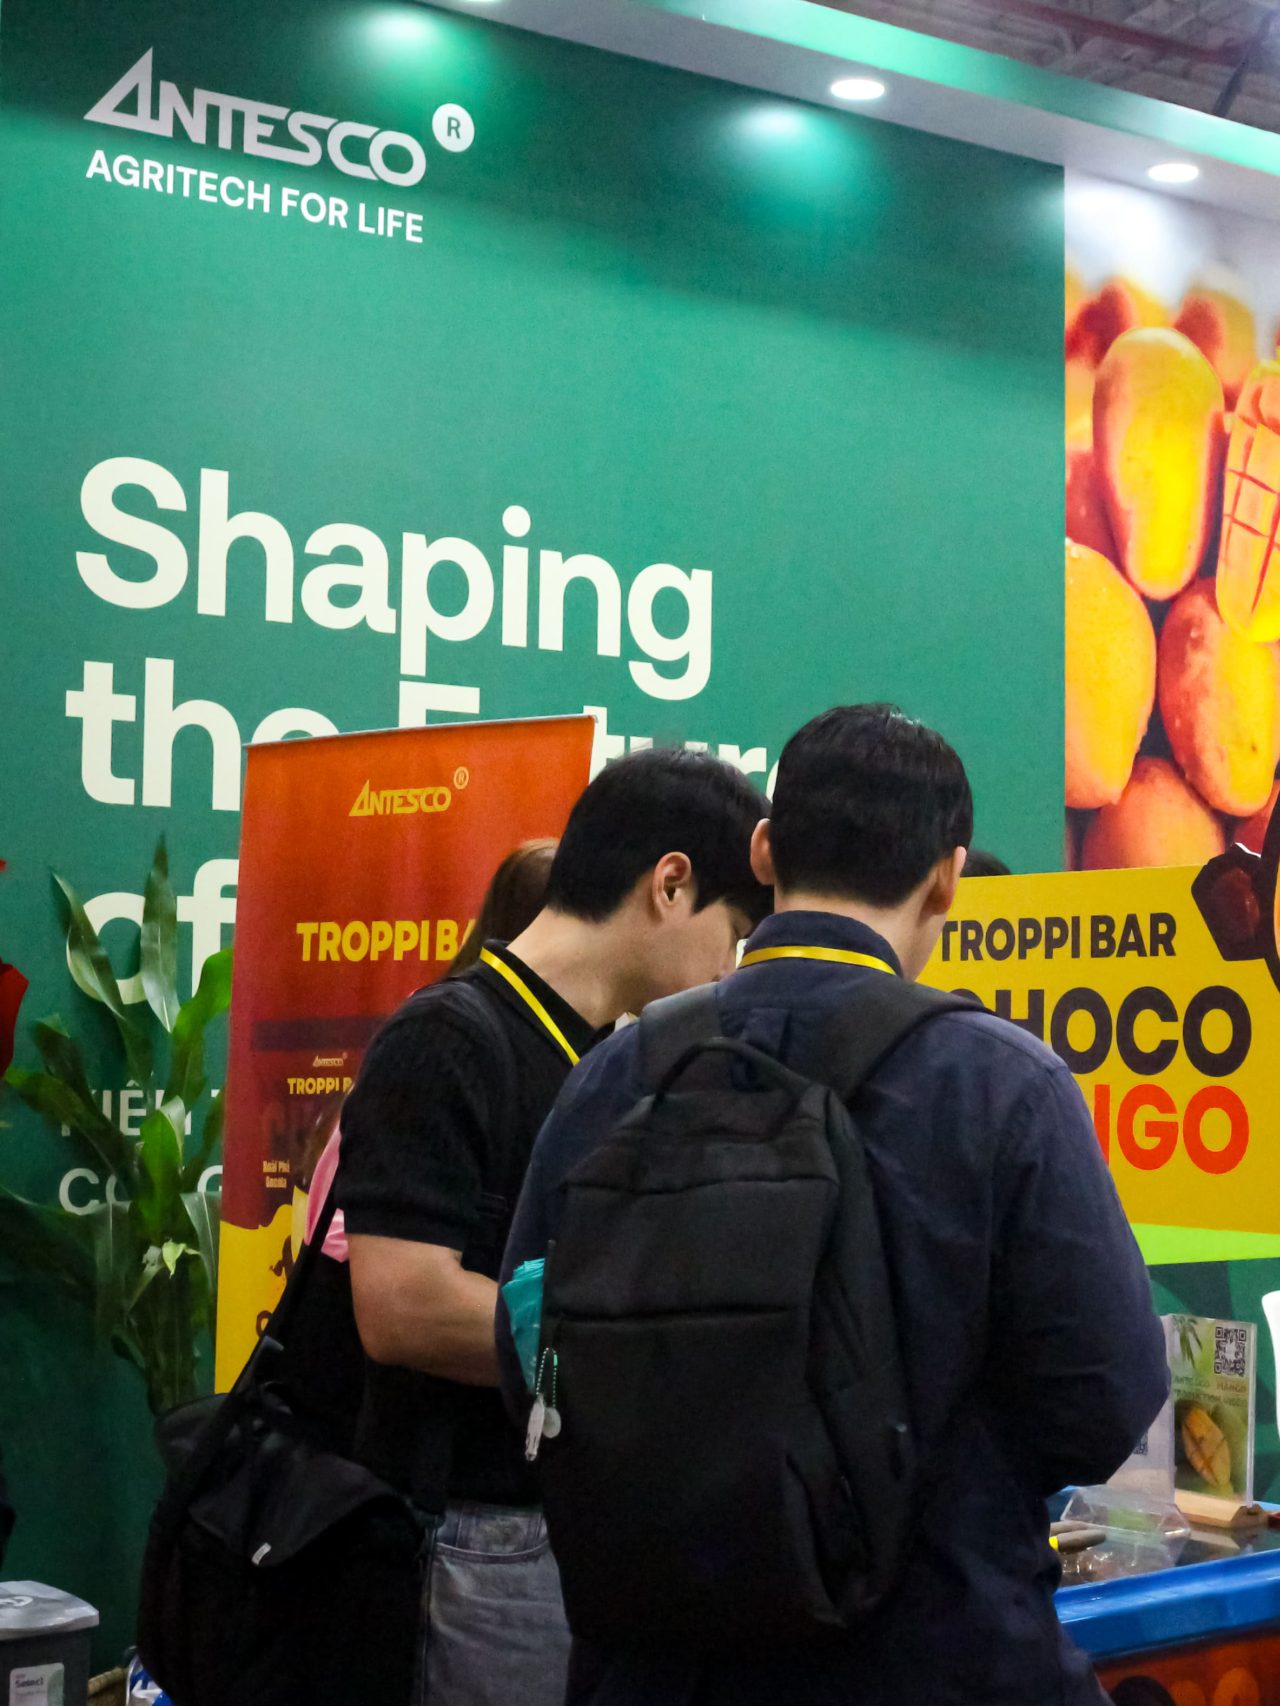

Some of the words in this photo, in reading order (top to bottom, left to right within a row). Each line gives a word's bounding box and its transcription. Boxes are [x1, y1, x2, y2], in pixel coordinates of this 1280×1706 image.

[83, 47, 427, 187] ANTESCO
[86, 150, 270, 213] AGRITECH
[281, 188, 348, 229] FOR
[359, 203, 423, 243] LIFE
[76, 456, 712, 700] Shaping
[349, 779, 451, 817] ANTESCO
[296, 919, 430, 962] TROPPI
[942, 915, 1081, 962] TROPPI
[1090, 912, 1177, 958] BAR
[948, 985, 1252, 1077] HOCO
[287, 1076, 340, 1095] TROPPI
